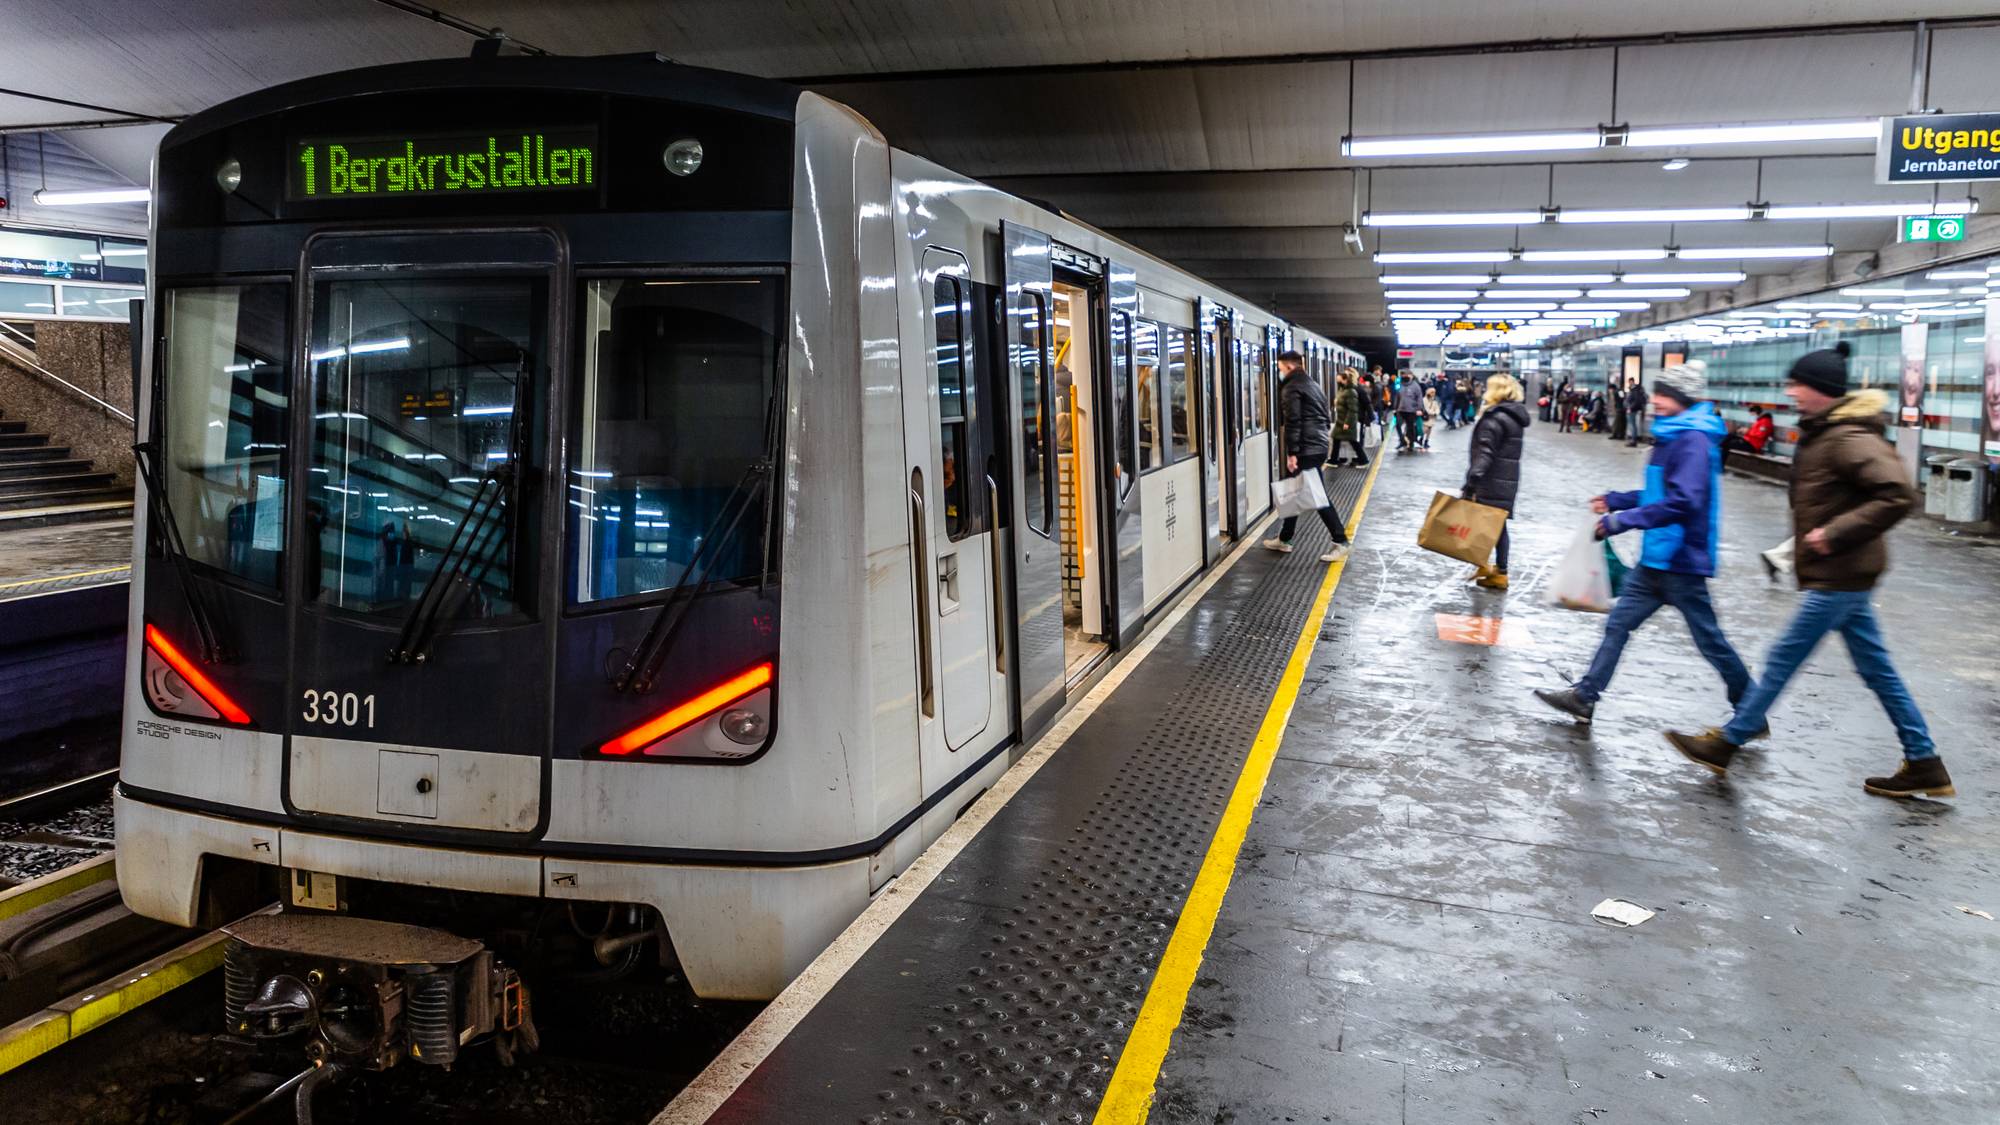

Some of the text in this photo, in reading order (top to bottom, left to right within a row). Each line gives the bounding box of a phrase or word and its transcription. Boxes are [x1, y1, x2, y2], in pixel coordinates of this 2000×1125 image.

[1902, 126, 2000, 154] Utgang
[300, 135, 592, 194] 1 Bergkrystallen
[302, 688, 375, 728] 3301
[136, 727, 170, 739] STUDIO
[137, 720, 222, 740] PORSCHE DESIGN
